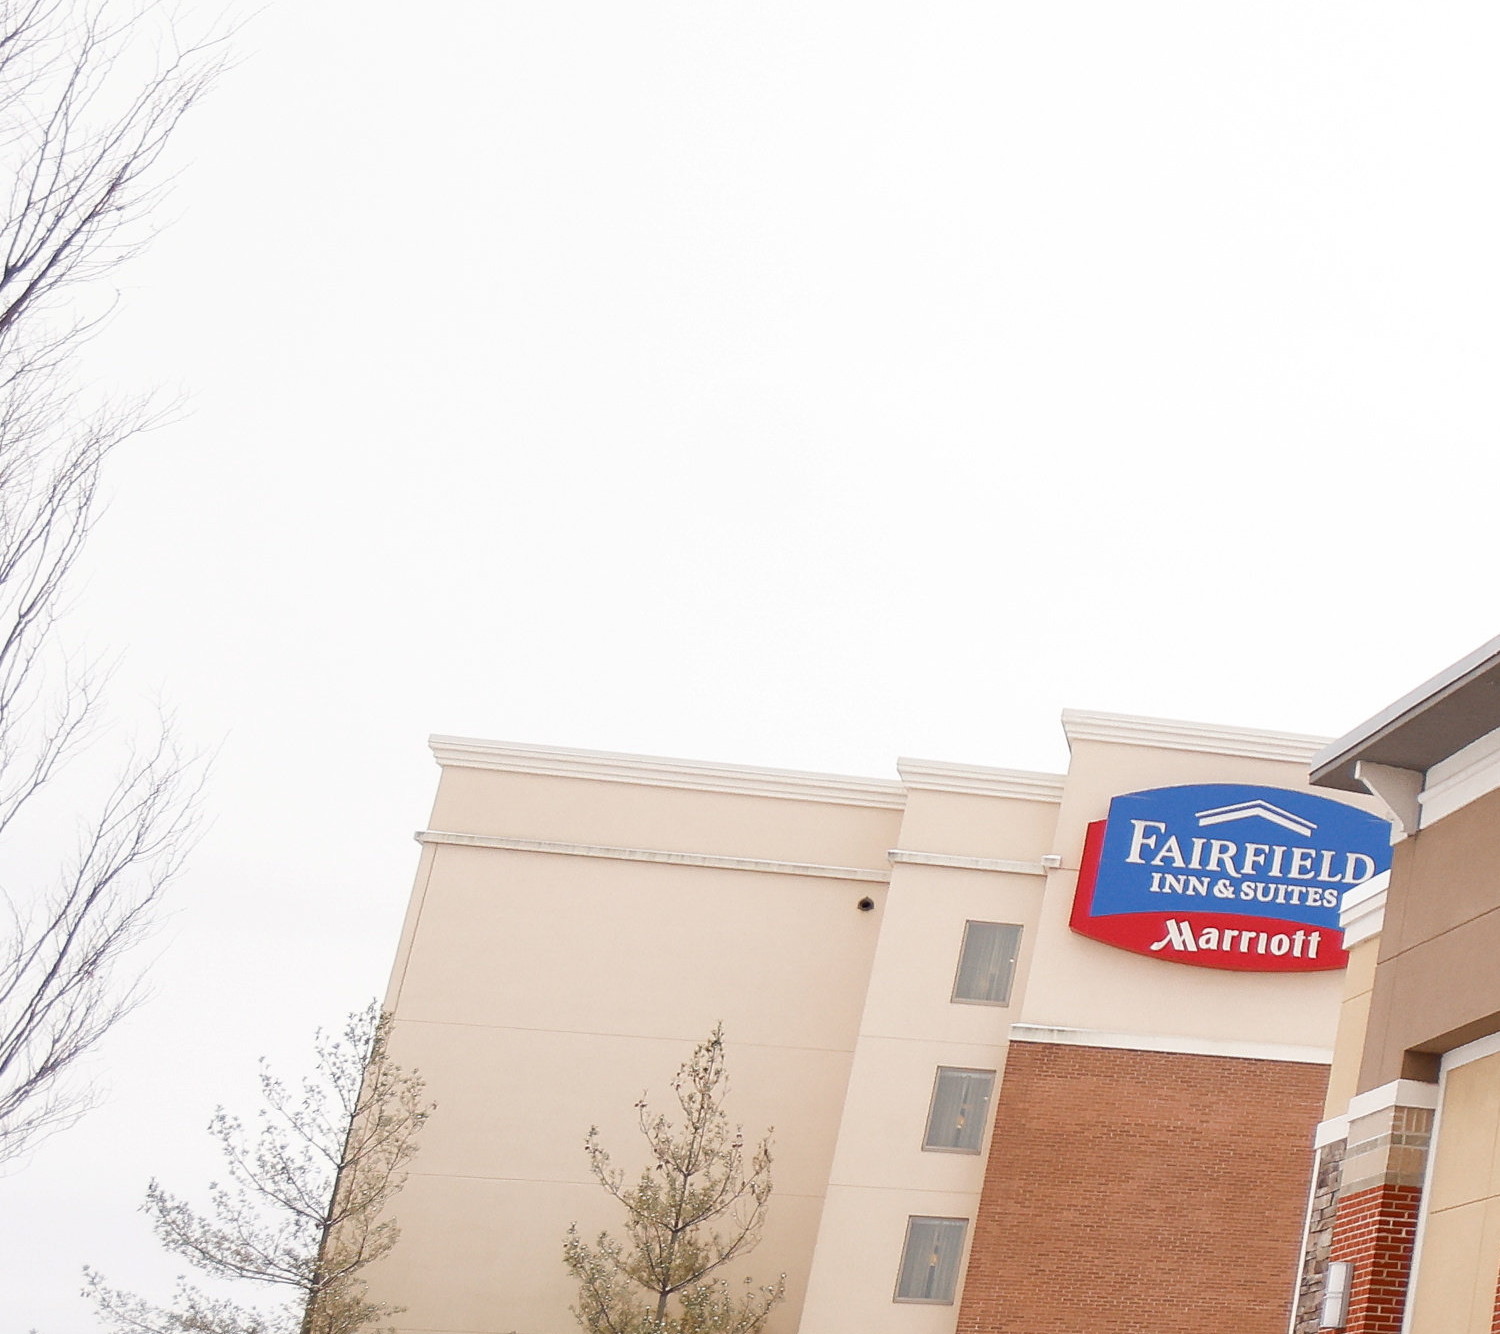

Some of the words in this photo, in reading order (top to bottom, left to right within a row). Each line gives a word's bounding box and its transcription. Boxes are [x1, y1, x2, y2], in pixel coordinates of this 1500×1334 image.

[1125, 819, 1376, 884] FAIRFIELD
[1150, 872, 1211, 896] INN
[1213, 878, 1236, 899] &
[1240, 881, 1338, 908] SUITES
[1150, 918, 1322, 959] Marriott
